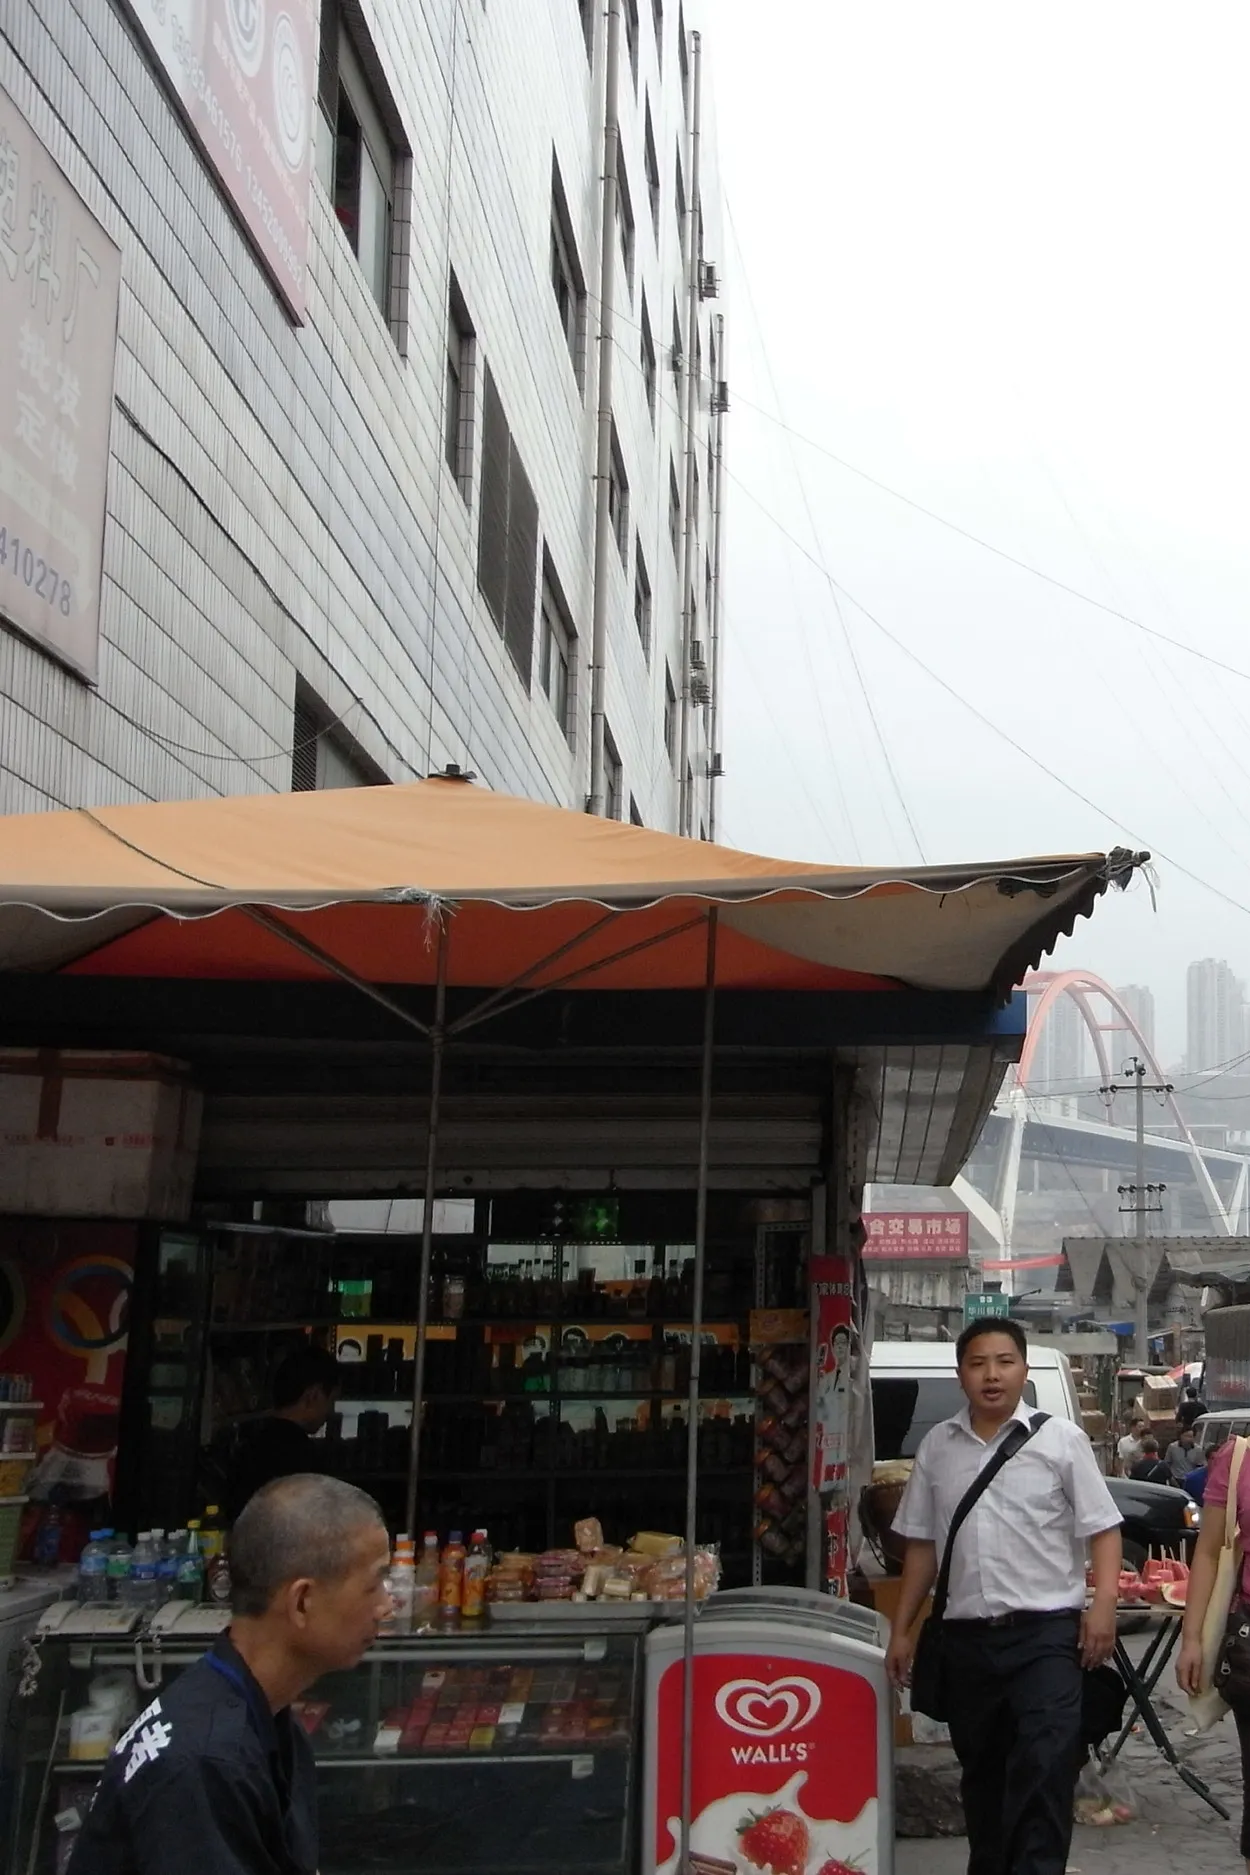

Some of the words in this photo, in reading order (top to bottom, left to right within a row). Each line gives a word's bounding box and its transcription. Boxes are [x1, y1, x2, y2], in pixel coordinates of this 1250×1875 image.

[863, 1217, 961, 1236] 合交易市场
[731, 1742, 808, 1765] WALL'S
